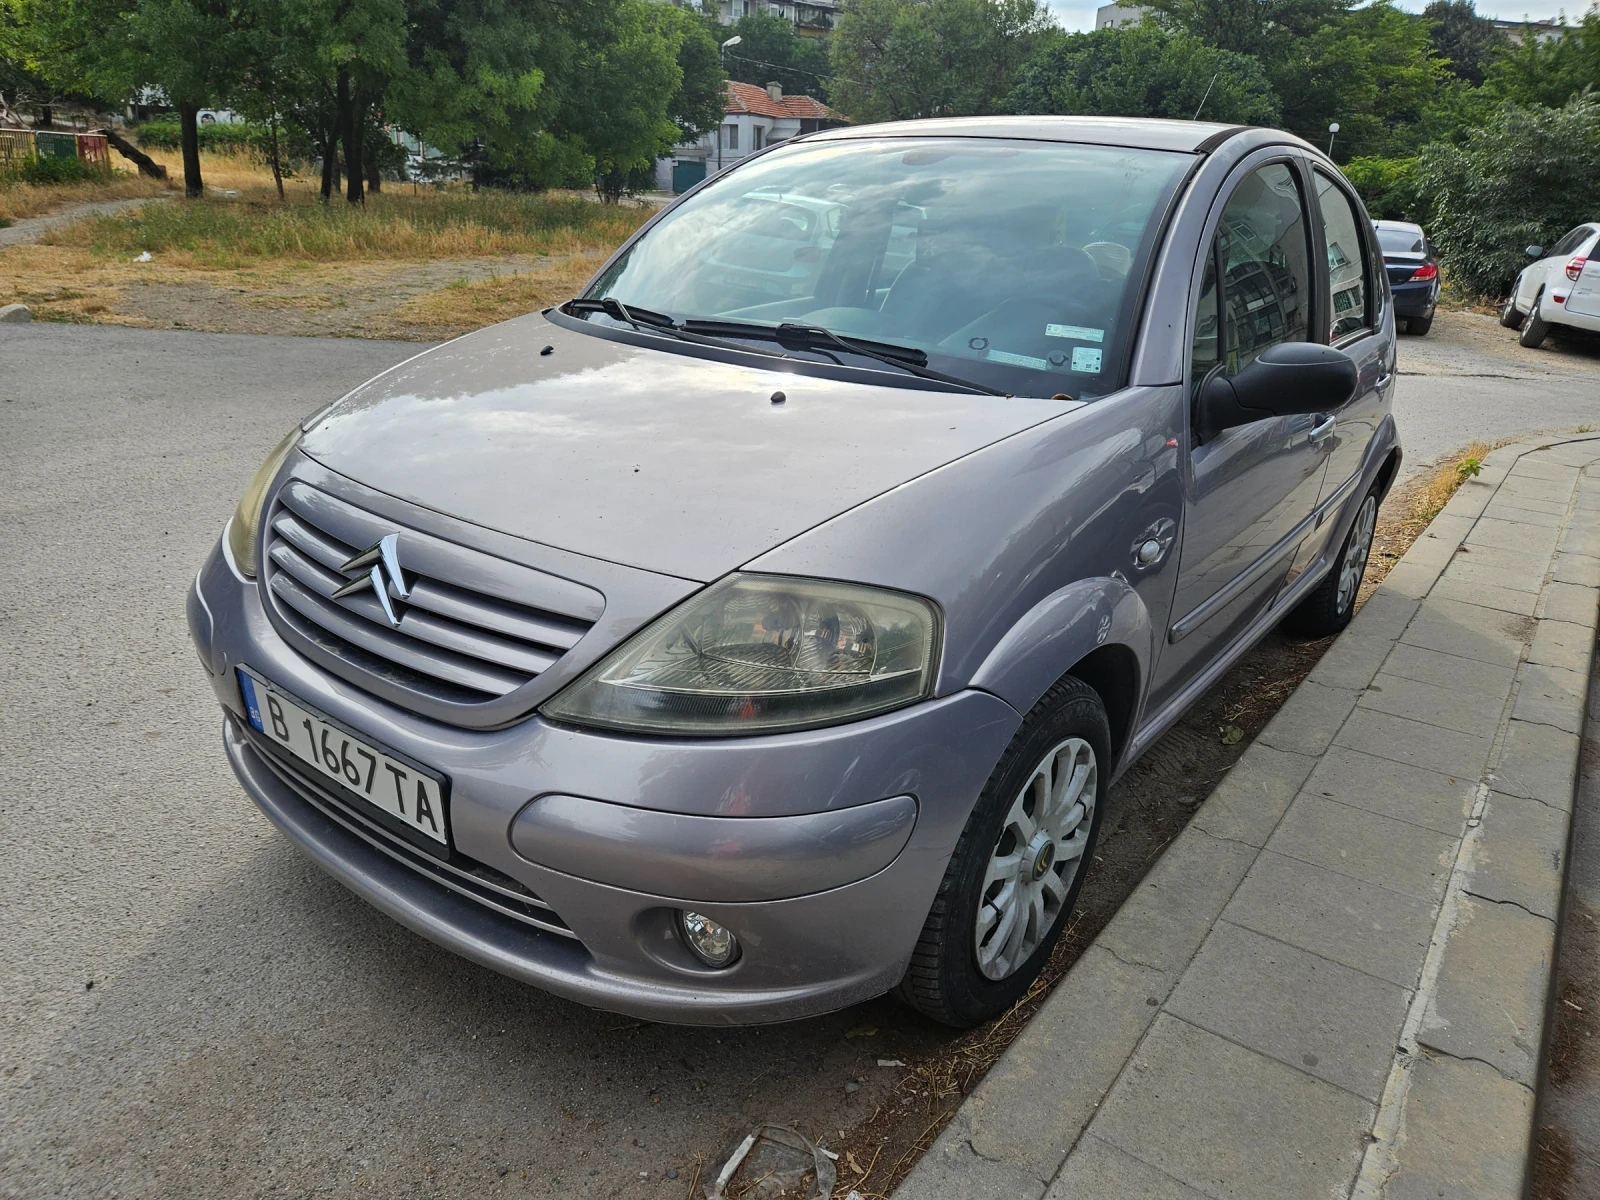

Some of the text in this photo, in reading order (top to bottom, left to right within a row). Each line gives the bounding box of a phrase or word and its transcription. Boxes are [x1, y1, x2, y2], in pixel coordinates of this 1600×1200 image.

[249, 706, 261, 722] BG
[266, 694, 438, 834] B 1667 TA
